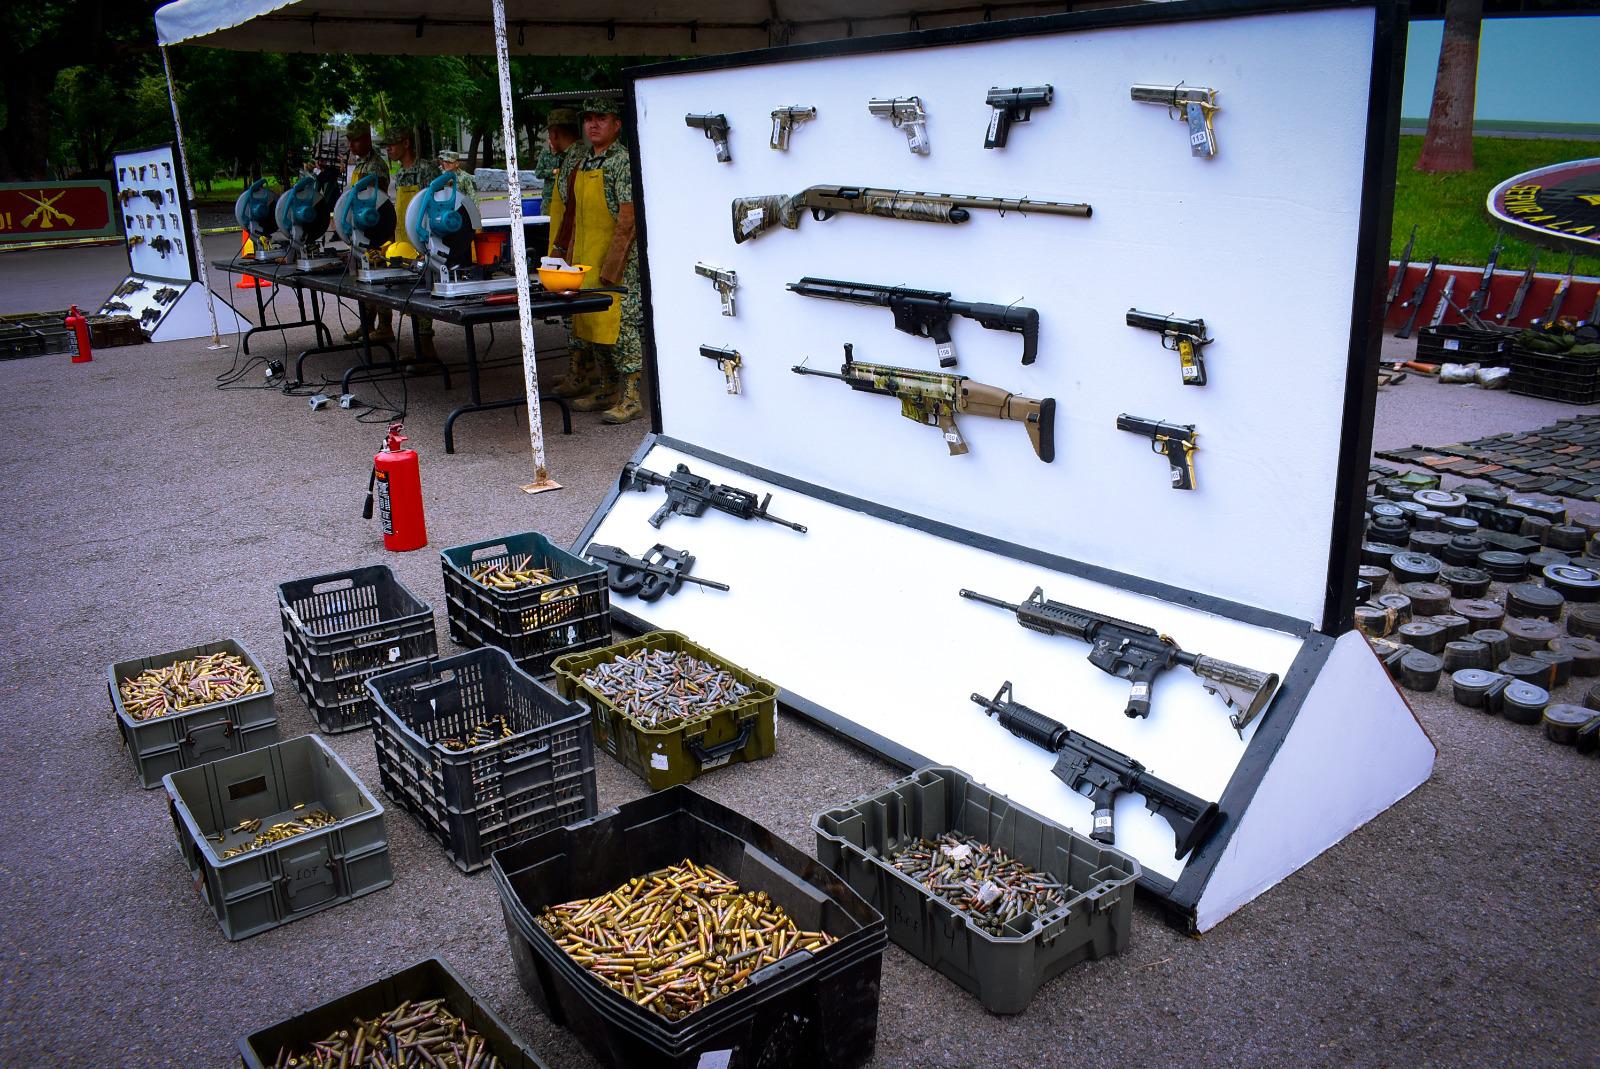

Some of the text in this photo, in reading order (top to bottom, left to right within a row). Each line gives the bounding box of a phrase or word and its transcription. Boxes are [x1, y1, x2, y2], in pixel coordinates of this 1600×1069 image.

[1192, 133, 1205, 143] 113
[1504, 185, 1544, 214] SERVIR
[1545, 220, 1596, 234] LA
